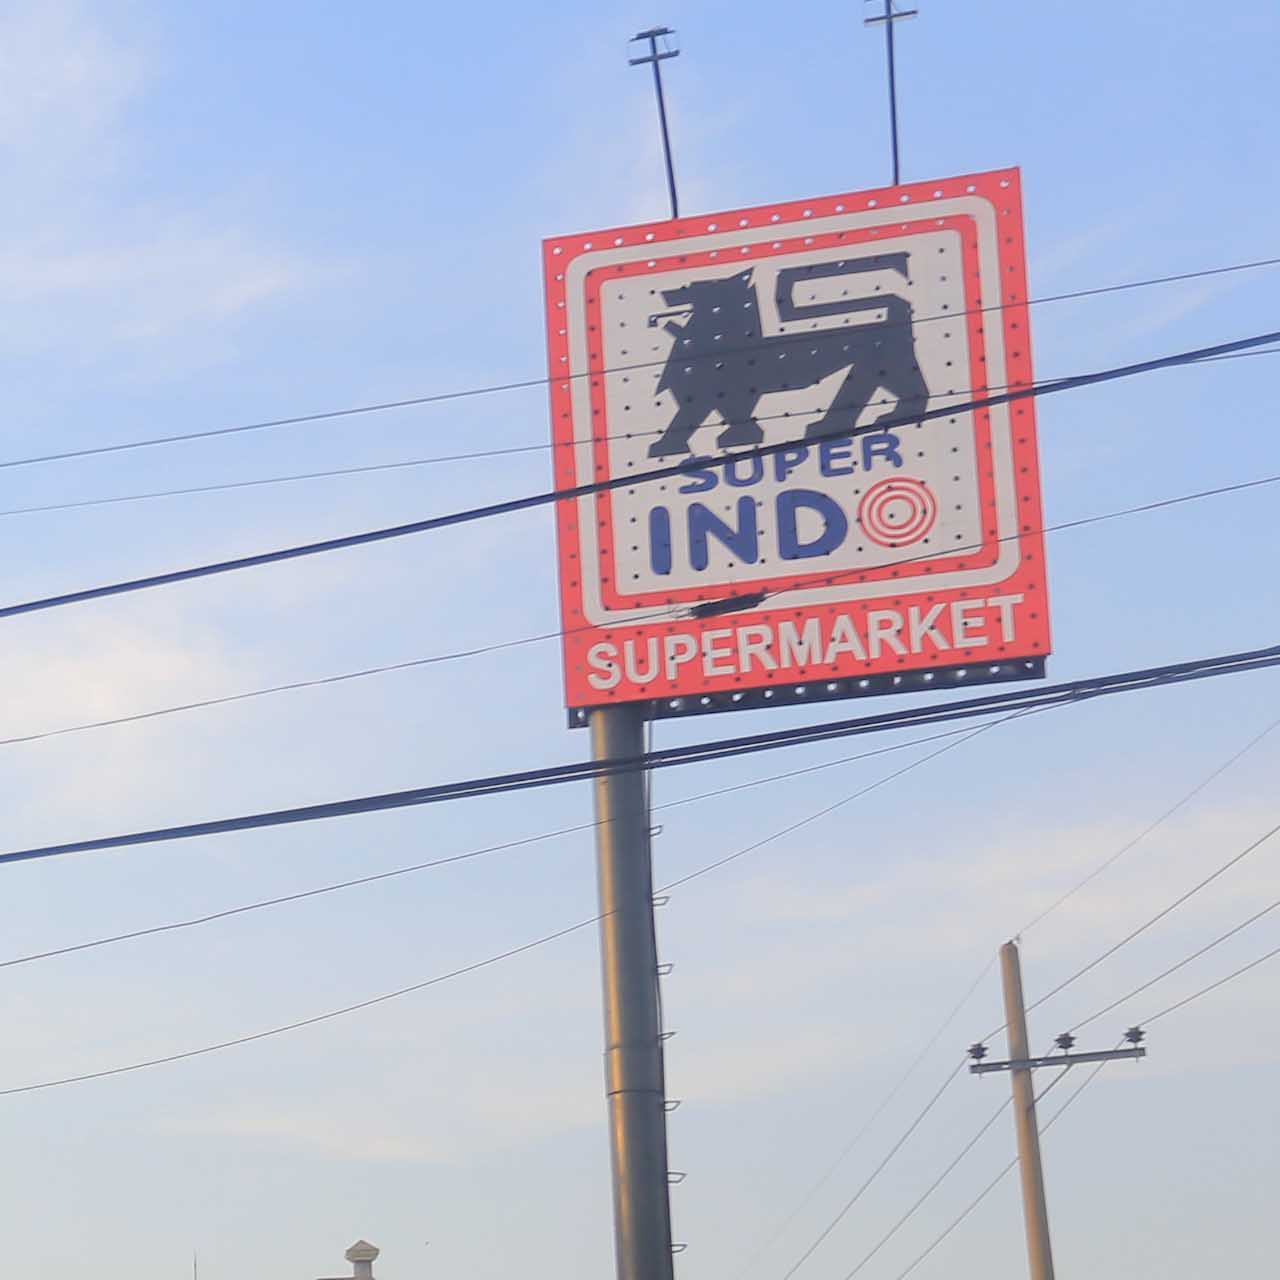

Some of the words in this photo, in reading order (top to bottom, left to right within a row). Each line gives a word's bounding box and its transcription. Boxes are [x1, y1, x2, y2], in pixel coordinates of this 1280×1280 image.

[678, 433, 903, 494] SUPER
[649, 477, 936, 575] INDO
[586, 594, 1025, 690] SUPERMARKET
